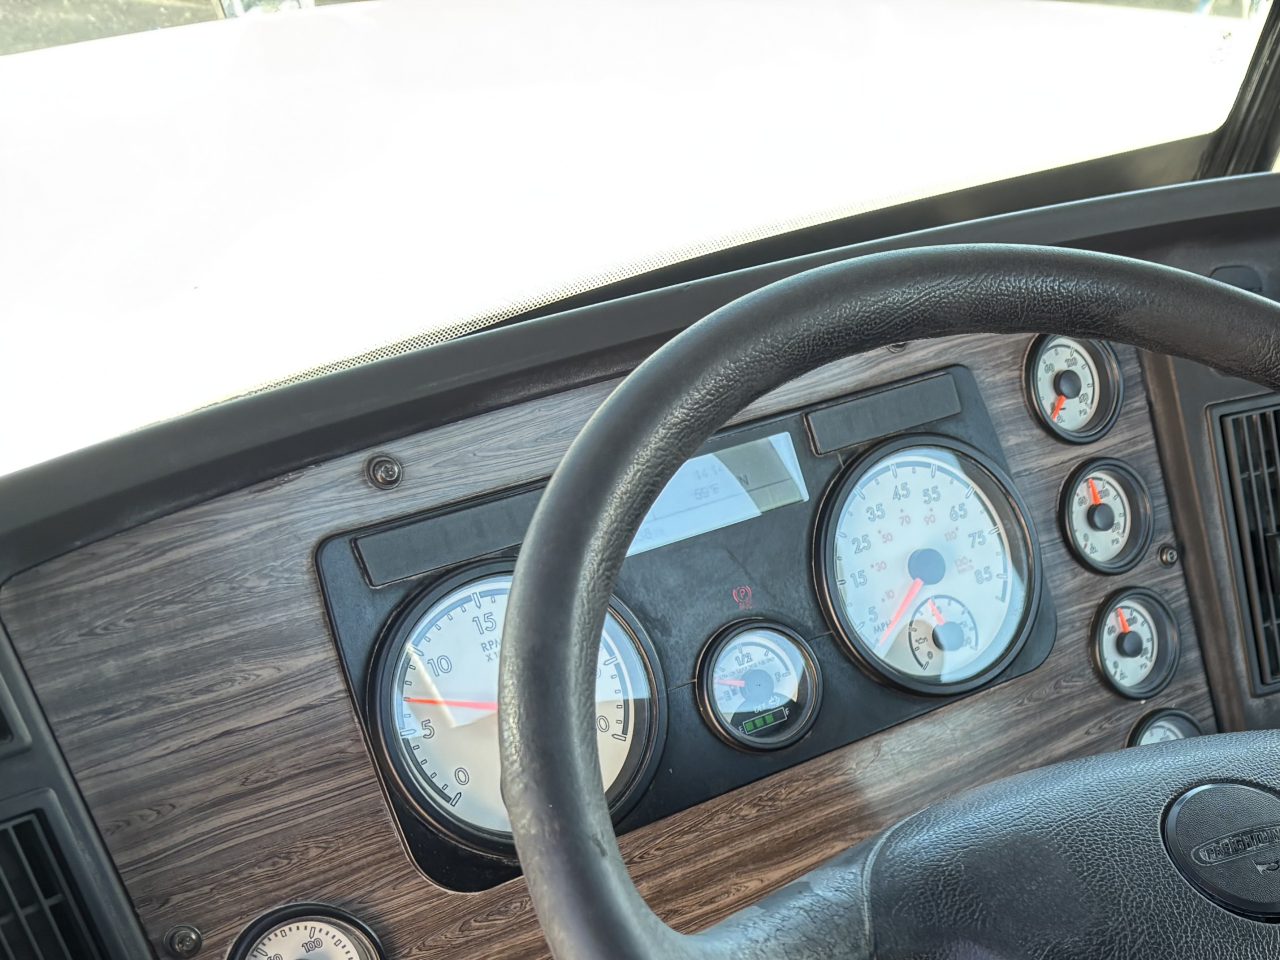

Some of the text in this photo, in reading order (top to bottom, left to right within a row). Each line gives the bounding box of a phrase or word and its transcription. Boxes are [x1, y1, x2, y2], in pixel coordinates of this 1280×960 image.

[893, 482, 911, 501] 45
[923, 486, 941, 504] 55
[866, 504, 886, 522] 35
[950, 503, 968, 521] 65
[852, 534, 872, 554] 25
[968, 530, 986, 549] 75
[850, 570, 868, 588] 15
[974, 566, 993, 585] 85
[472, 612, 496, 635] 15
[868, 606, 879, 623] 5
[427, 655, 453, 677] 10
[421, 719, 435, 739] 5
[454, 767, 470, 786] 0
[301, 938, 323, 953] 100
